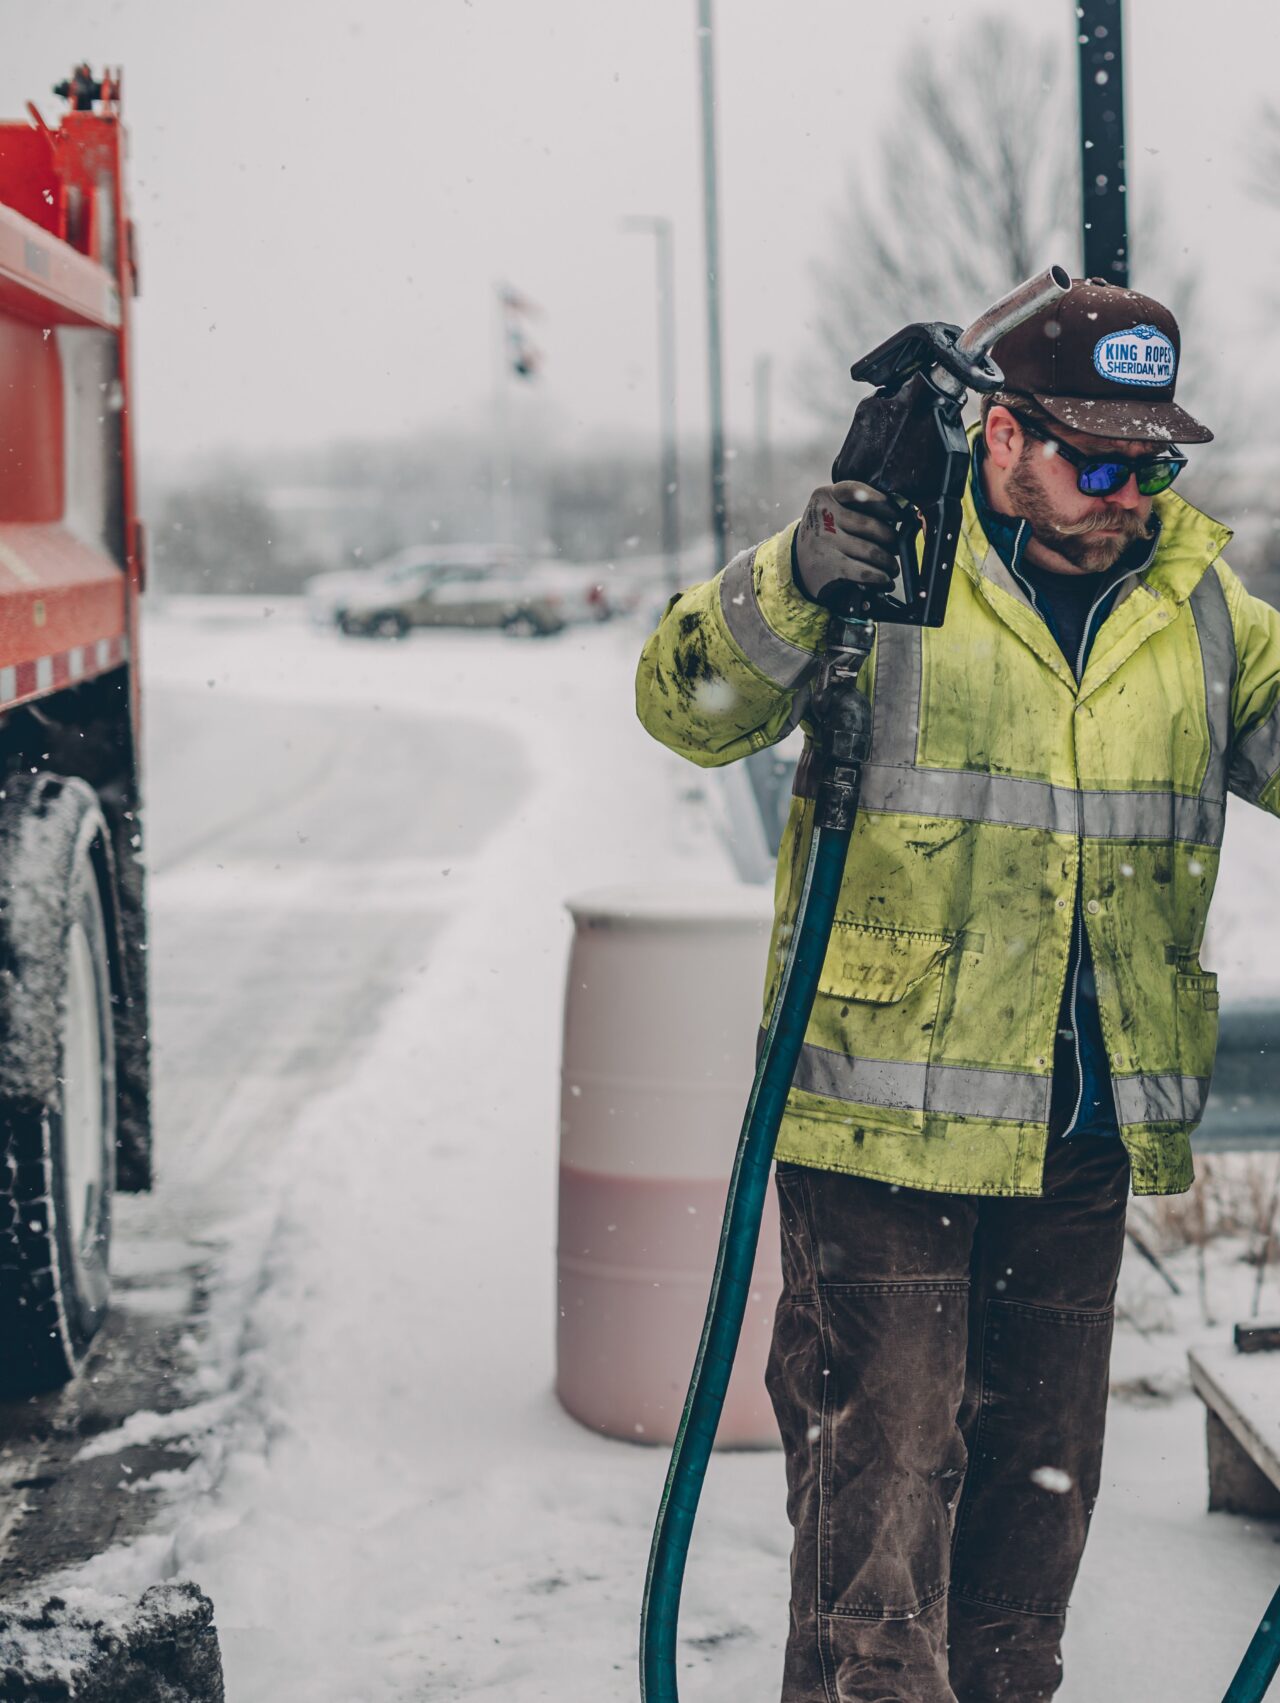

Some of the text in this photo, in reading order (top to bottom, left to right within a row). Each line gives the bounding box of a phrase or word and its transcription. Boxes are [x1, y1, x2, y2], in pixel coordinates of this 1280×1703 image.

[1106, 344, 1171, 363] KING ROPES
[1107, 362, 1156, 378] SHERIDAN,
[822, 508, 836, 535] 3M
